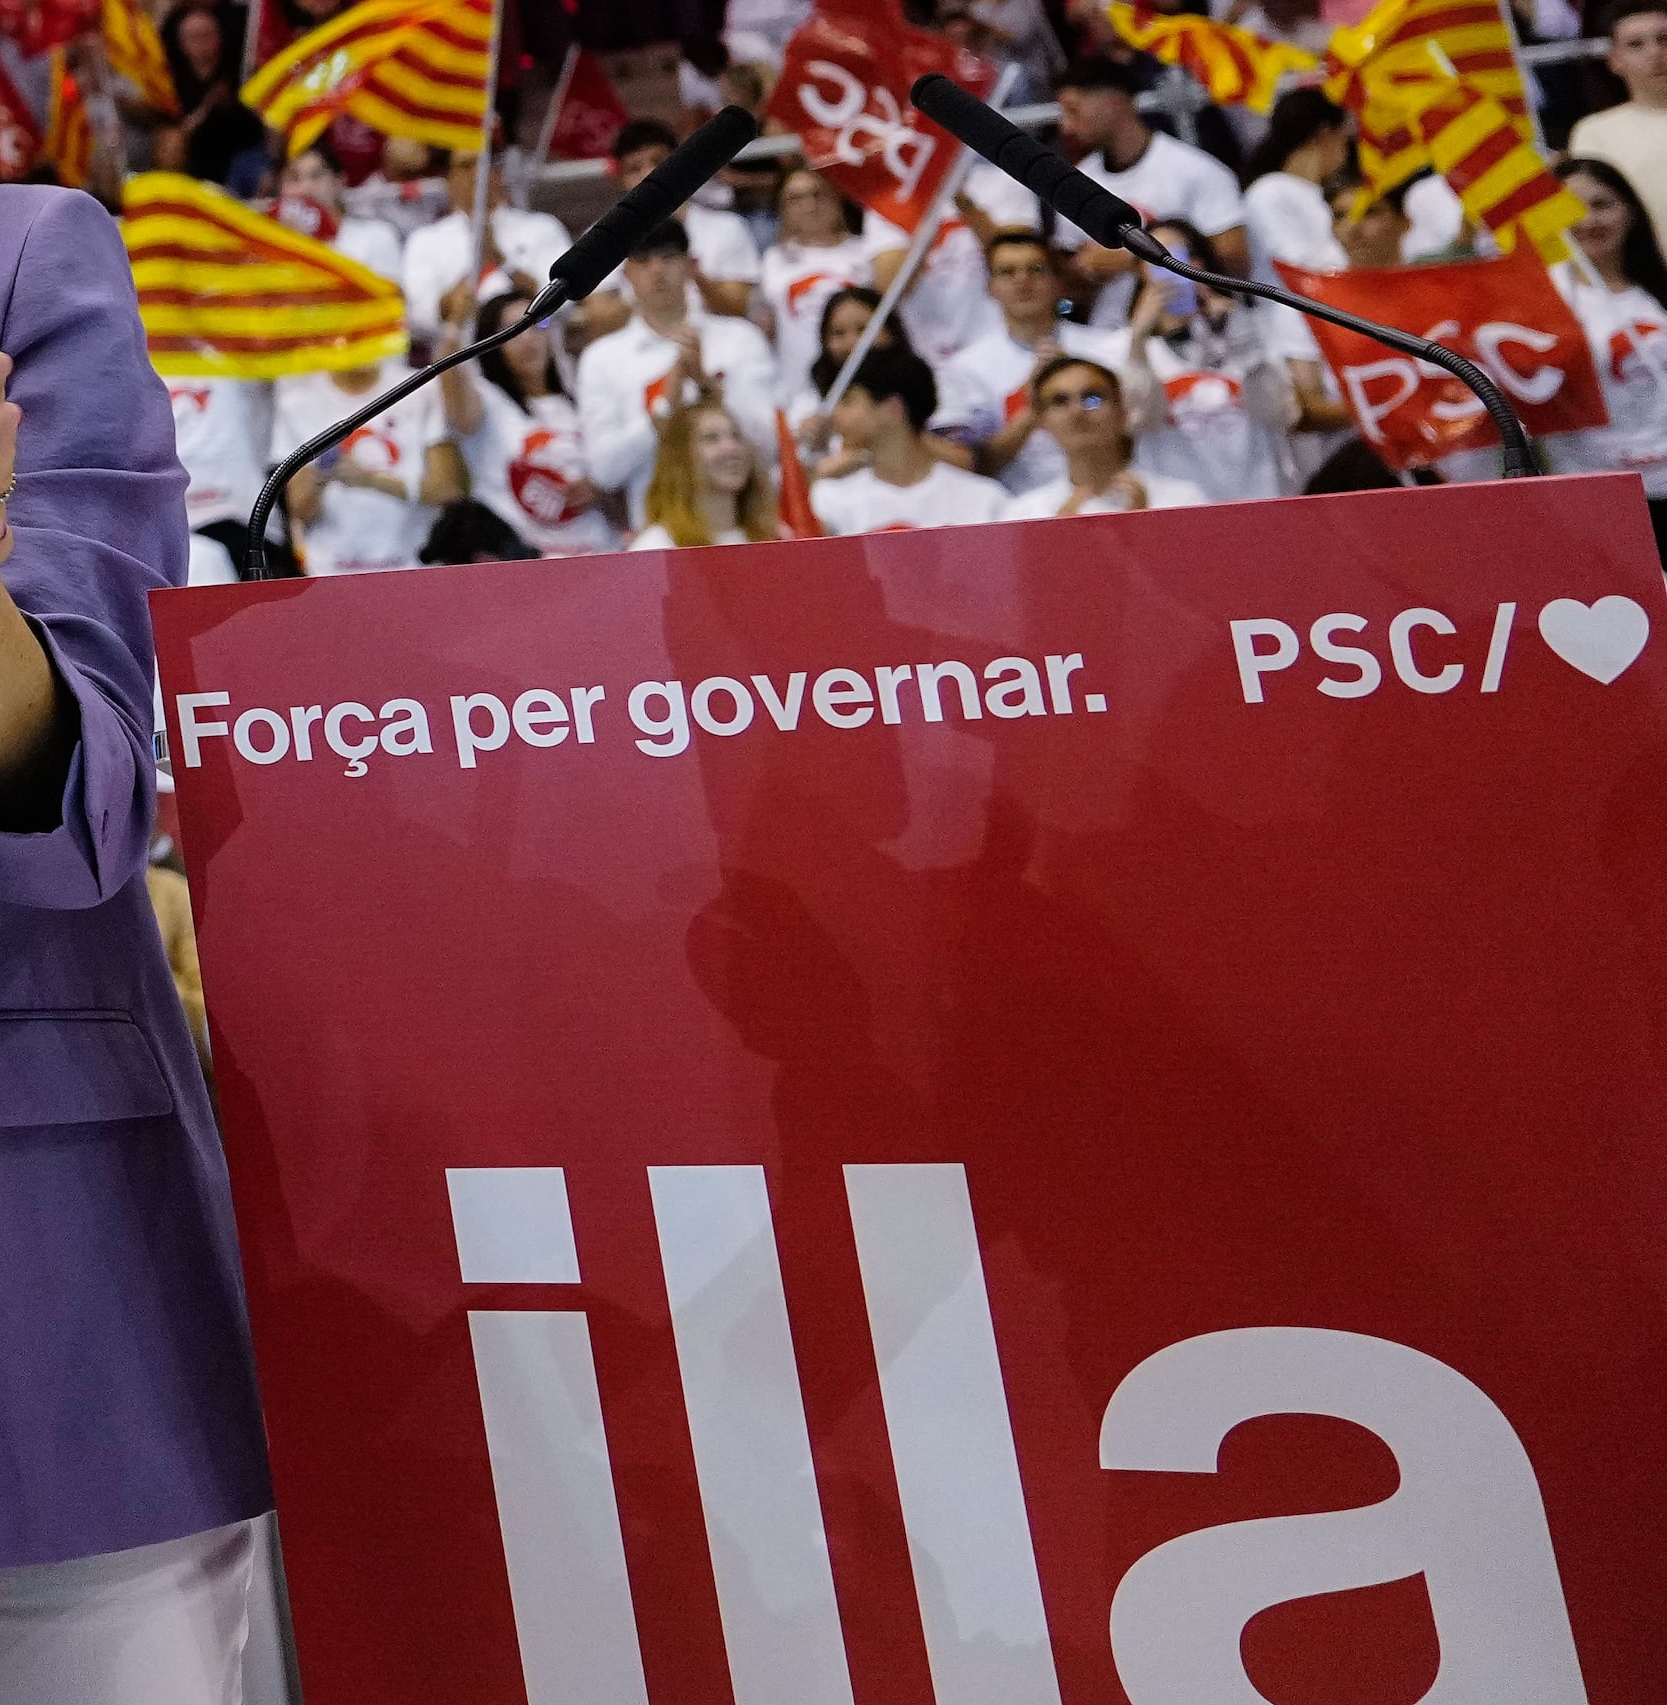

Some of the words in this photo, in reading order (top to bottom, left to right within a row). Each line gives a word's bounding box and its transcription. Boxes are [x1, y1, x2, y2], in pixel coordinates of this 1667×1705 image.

[177, 691, 433, 778] Força
[453, 683, 605, 769] per
[628, 648, 1108, 758] governar.
[444, 1162, 1592, 1705] illa
